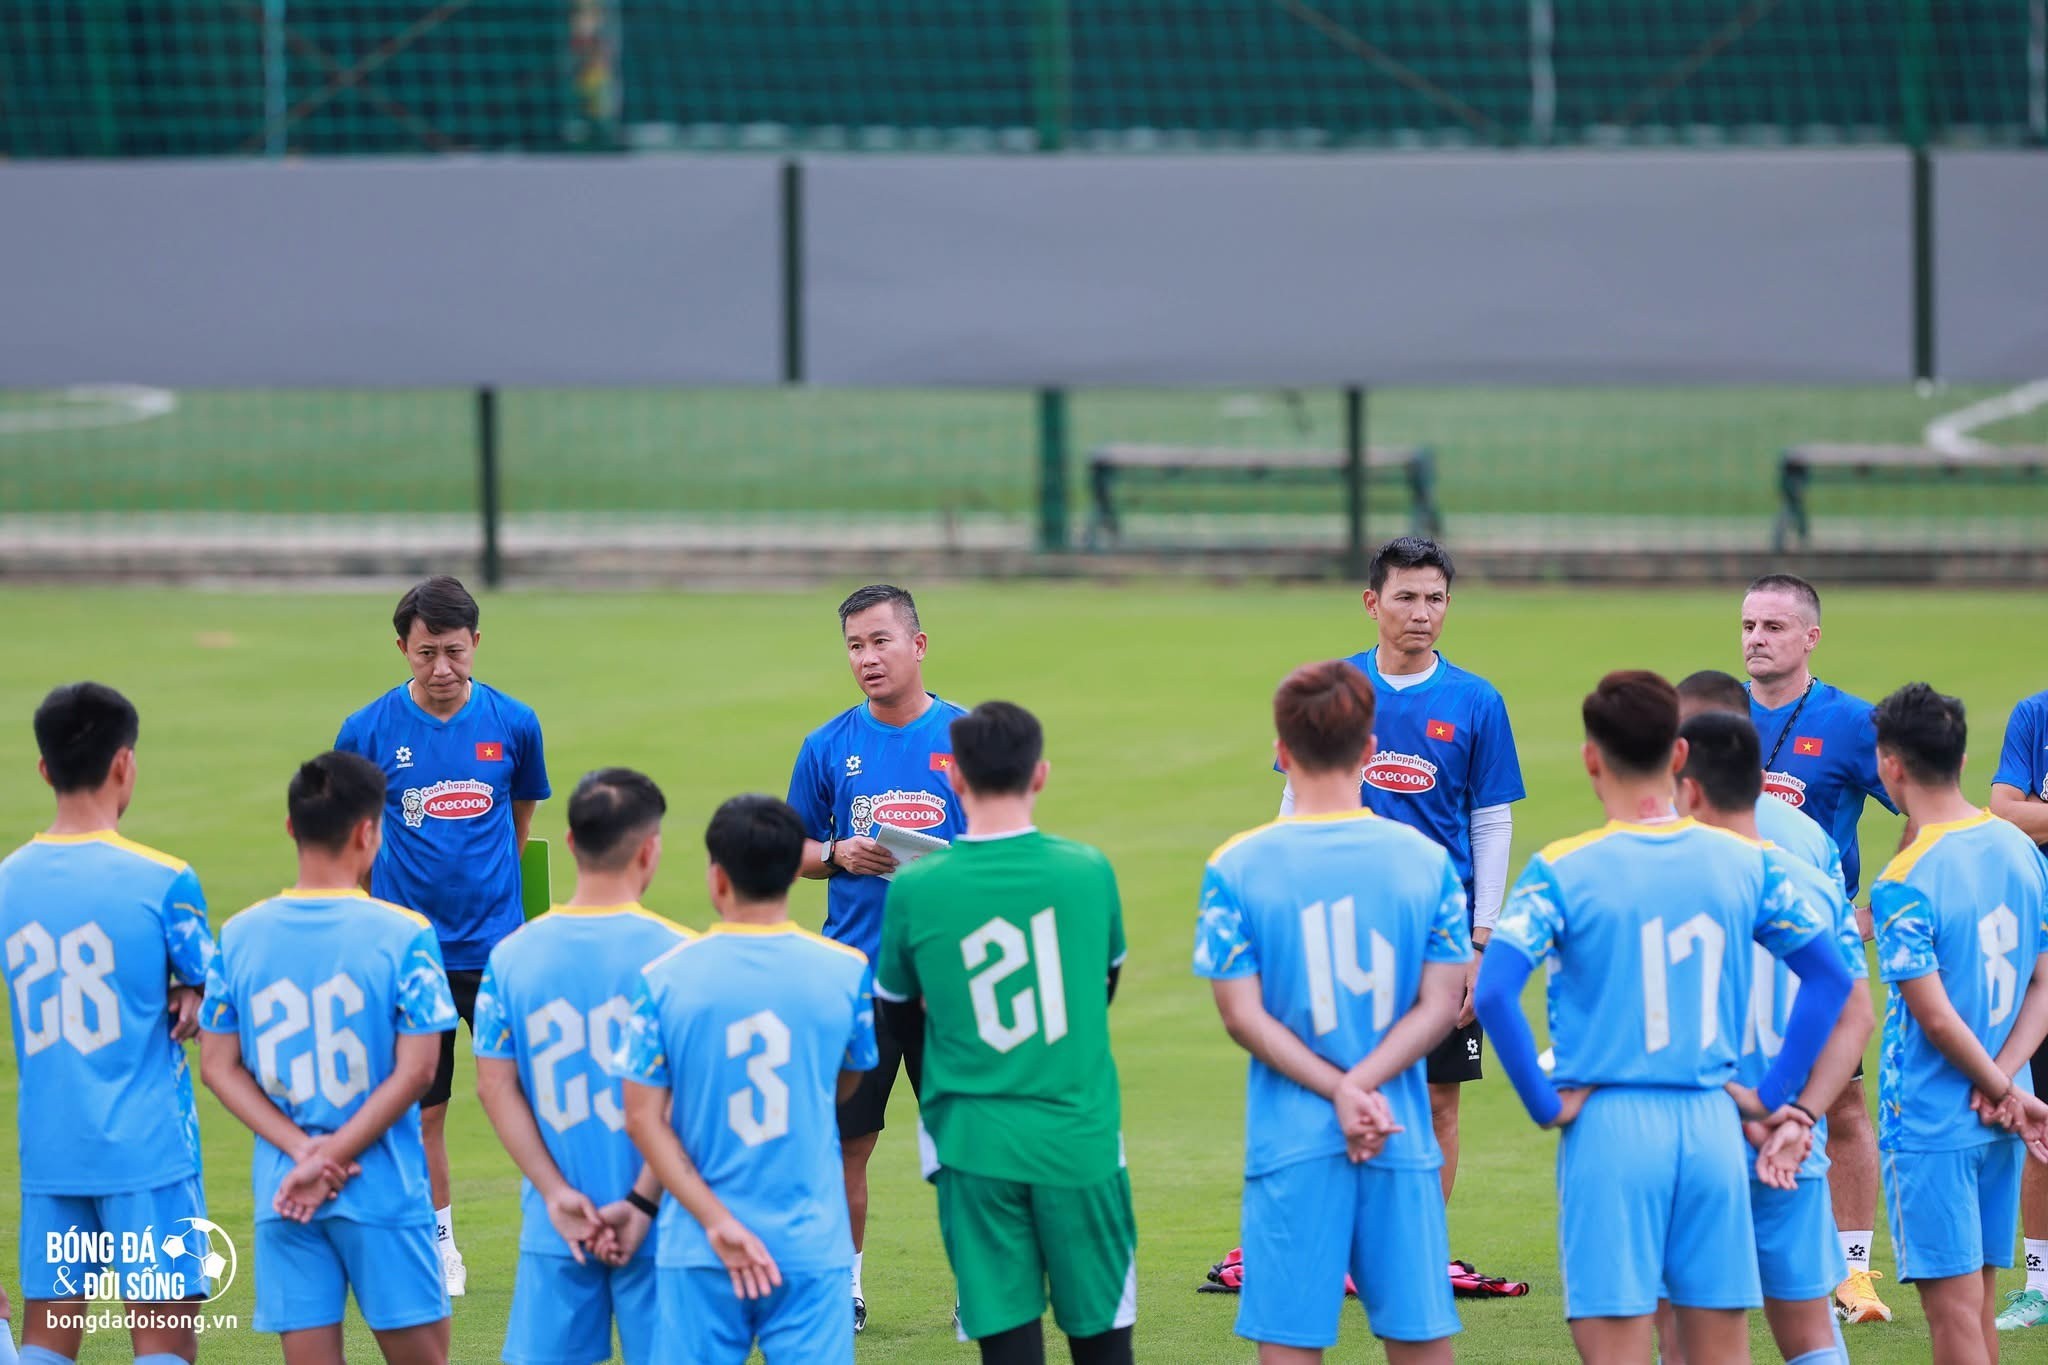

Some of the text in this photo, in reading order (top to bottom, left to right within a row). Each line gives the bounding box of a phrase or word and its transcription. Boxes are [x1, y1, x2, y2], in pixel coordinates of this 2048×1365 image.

[422, 781, 492, 796] Cook happiness
[872, 791, 945, 807] Cook happiness
[1371, 753, 1436, 773] ook happiness
[1767, 774, 1804, 789] appiness
[6, 921, 121, 1055] 28
[960, 907, 1068, 1053] 21
[1300, 896, 1395, 1036] 14
[1641, 912, 1726, 1053] 17
[1977, 903, 2019, 1026] 8
[252, 974, 369, 1106] 26
[726, 1010, 791, 1147] 3
